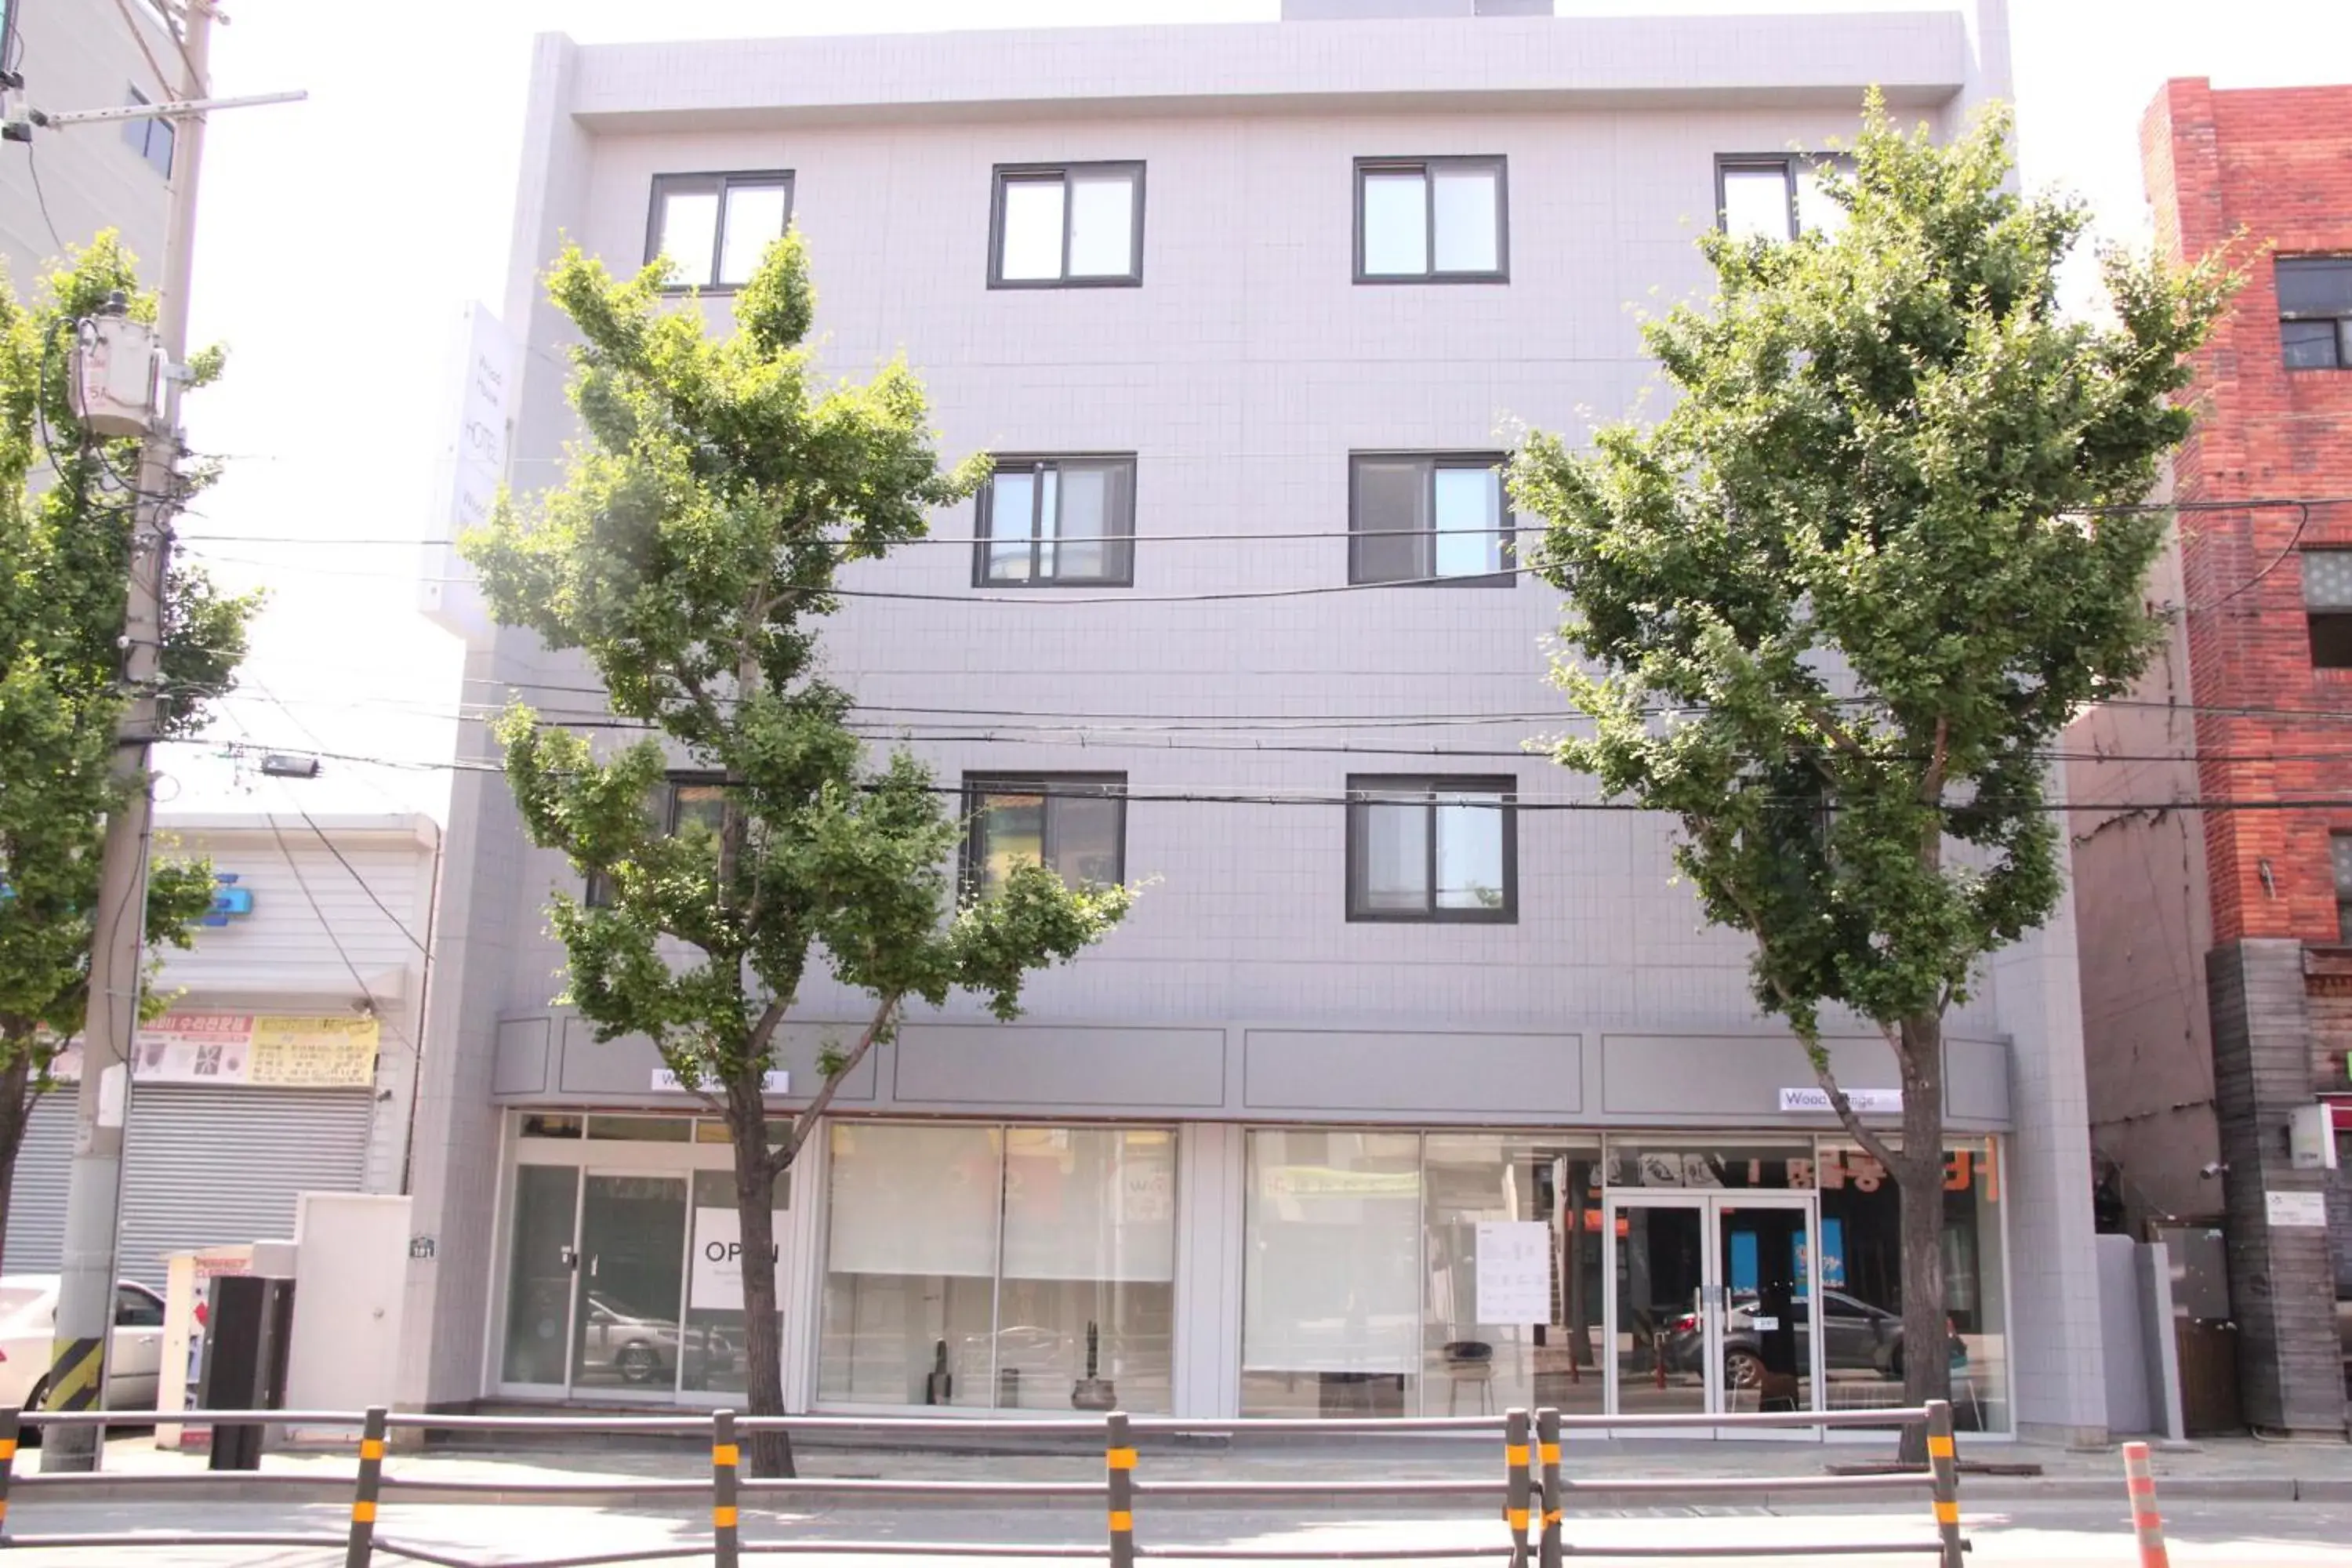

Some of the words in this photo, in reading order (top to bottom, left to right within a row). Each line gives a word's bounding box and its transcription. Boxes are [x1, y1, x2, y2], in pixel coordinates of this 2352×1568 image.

[466, 419, 499, 465] HOTEL
[1785, 1091, 1827, 1105] Wood
[705, 1240, 779, 1264] OP
